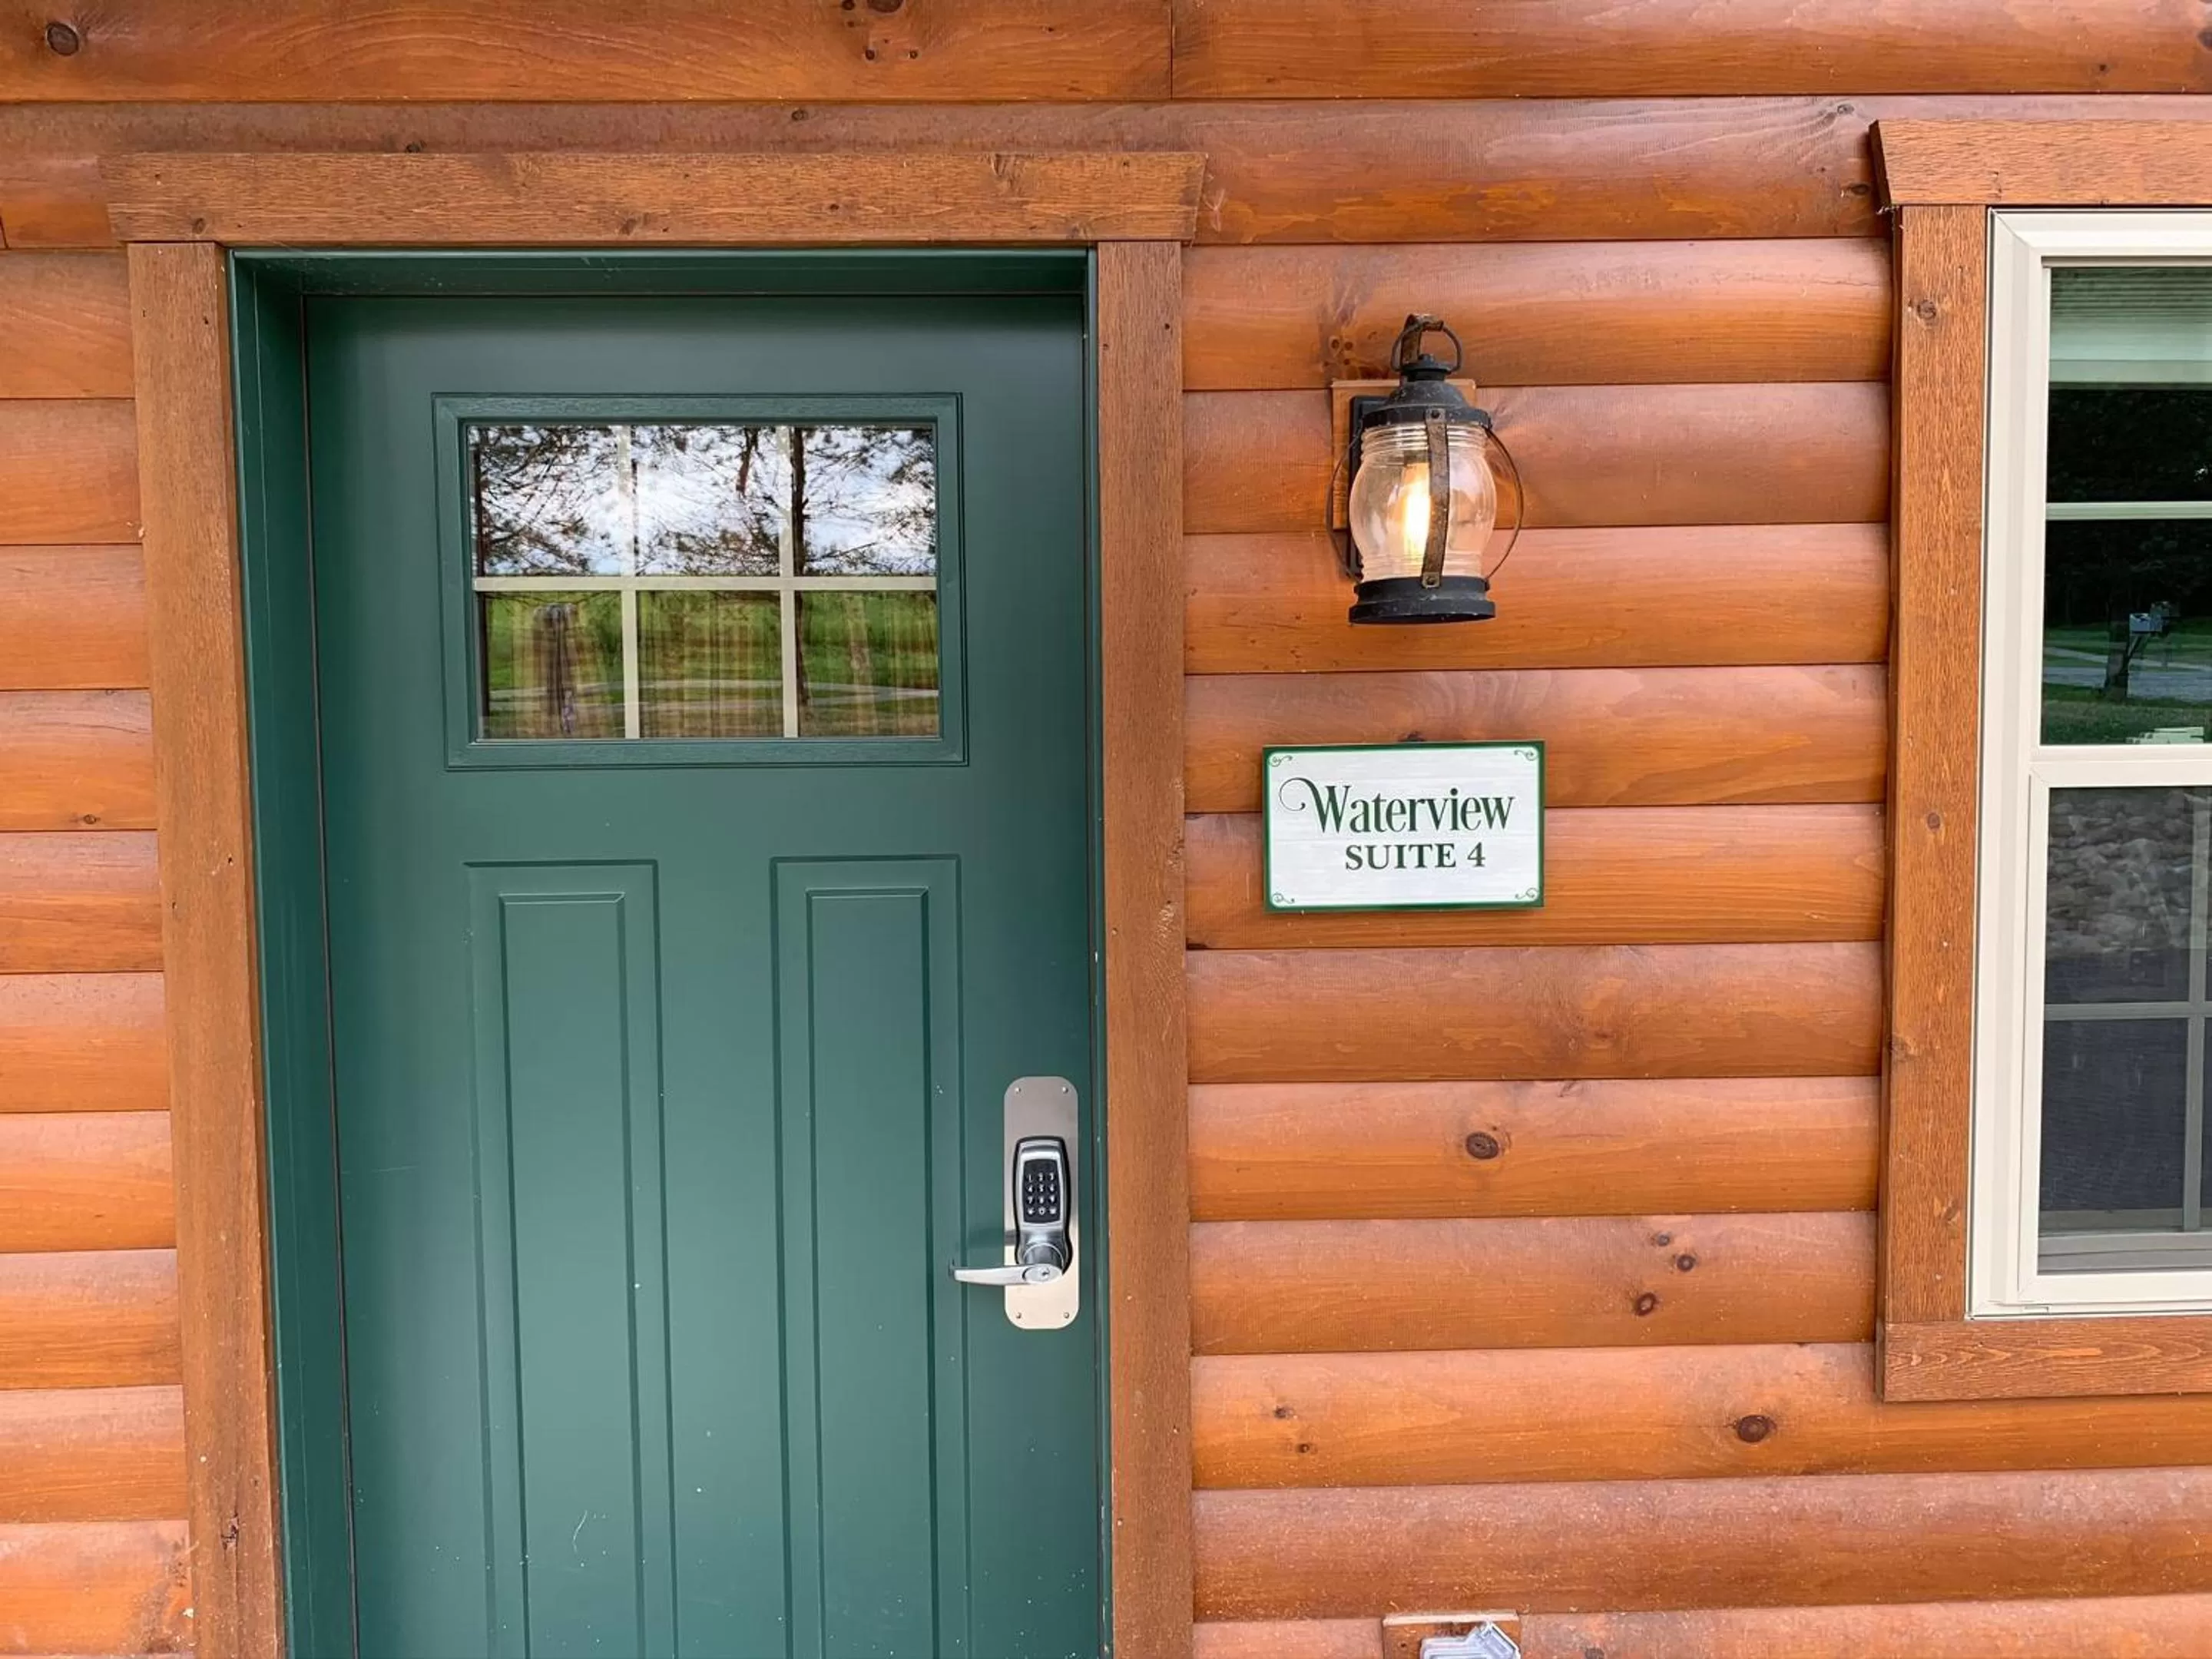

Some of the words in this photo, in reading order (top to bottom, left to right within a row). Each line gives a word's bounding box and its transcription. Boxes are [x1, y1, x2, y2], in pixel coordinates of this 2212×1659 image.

[1279, 777, 1515, 833] Waterview
[1346, 843, 1456, 870] SUITE
[1467, 842, 1485, 867] 4
